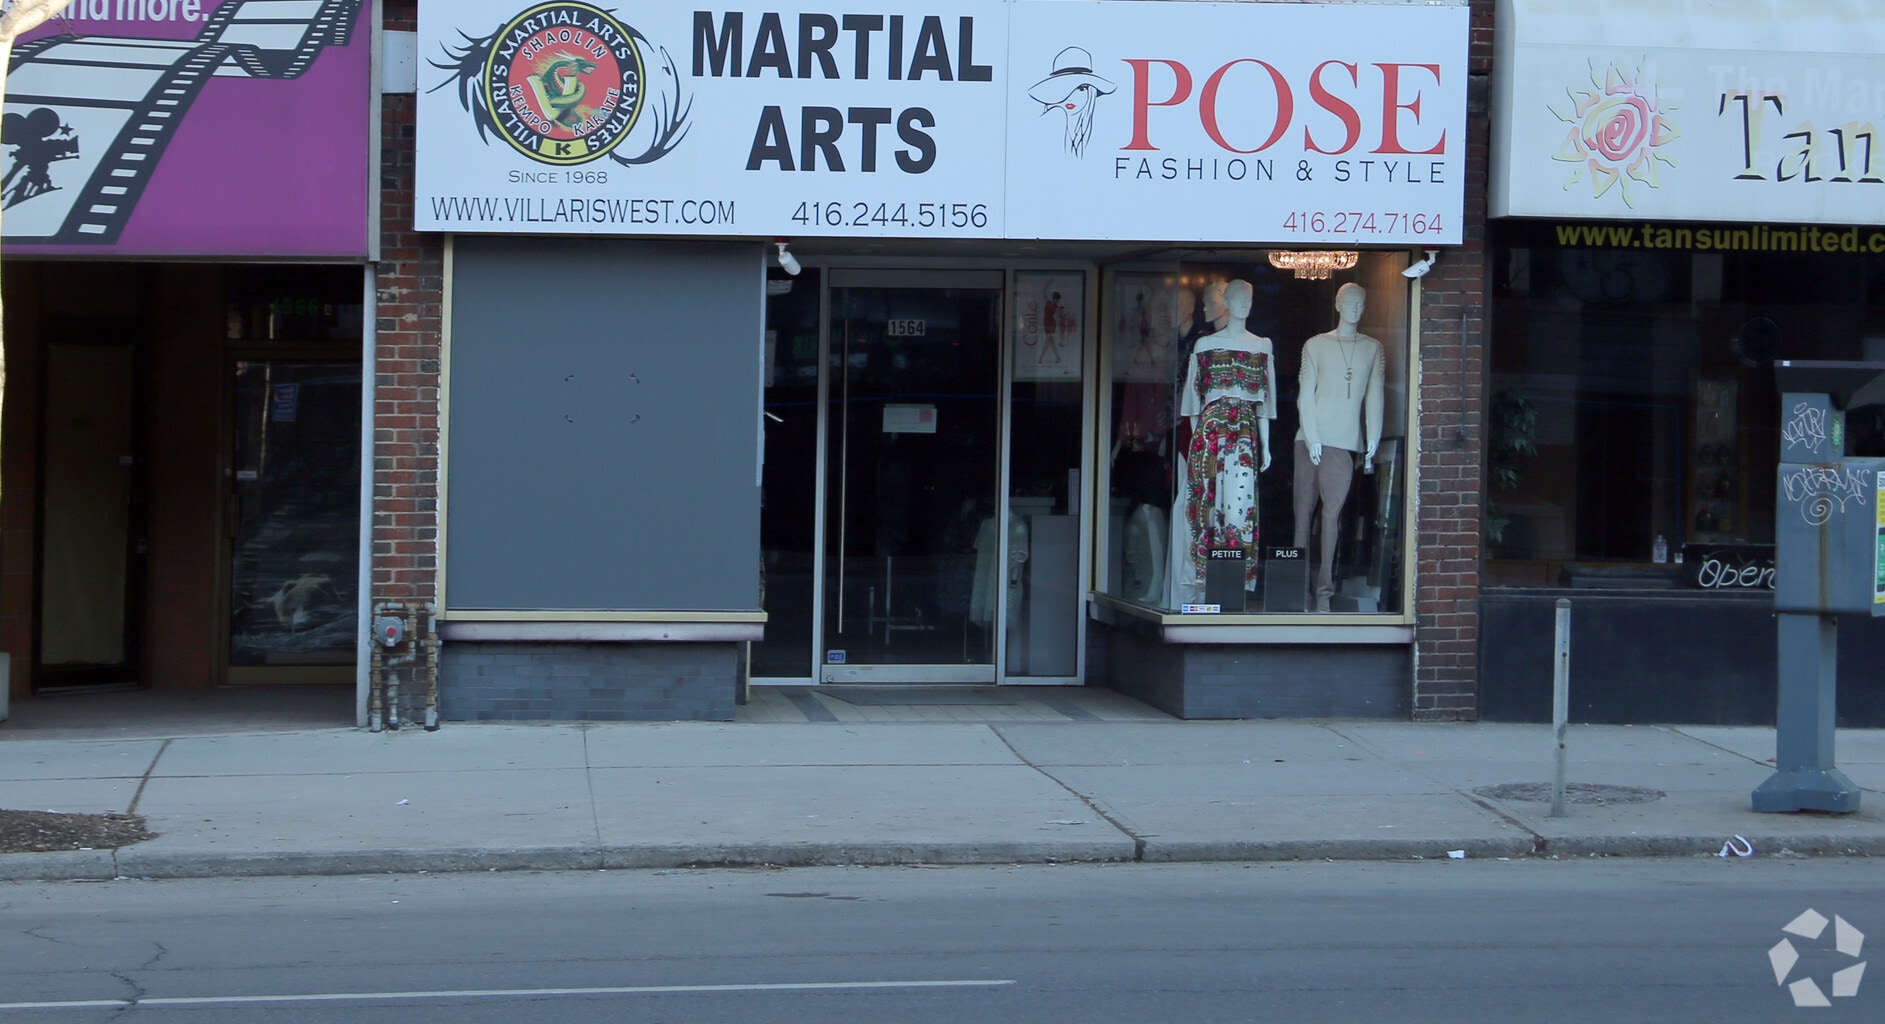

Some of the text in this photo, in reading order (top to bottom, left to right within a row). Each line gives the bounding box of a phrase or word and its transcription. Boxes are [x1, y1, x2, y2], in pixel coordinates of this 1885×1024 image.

[521, 29, 608, 60] SHAOLIN
[692, 10, 993, 82] MARTIAL
[492, 10, 637, 151] VILLARI'S MARTIAL ARTS CENTRES
[509, 84, 620, 136] KEMPO KARATE
[1119, 58, 1446, 155] POSE
[745, 105, 937, 174] ARTS
[565, 171, 608, 184] 1968
[1114, 157, 1446, 184] FASHION & STYLE
[431, 196, 736, 226] WWW.VILLARISWEST.COM
[791, 202, 988, 229] 416.244.5156
[1283, 211, 1444, 236] 416.274.7164
[891, 320, 925, 335] 1564
[1212, 550, 1298, 558] PETITE PLUS
